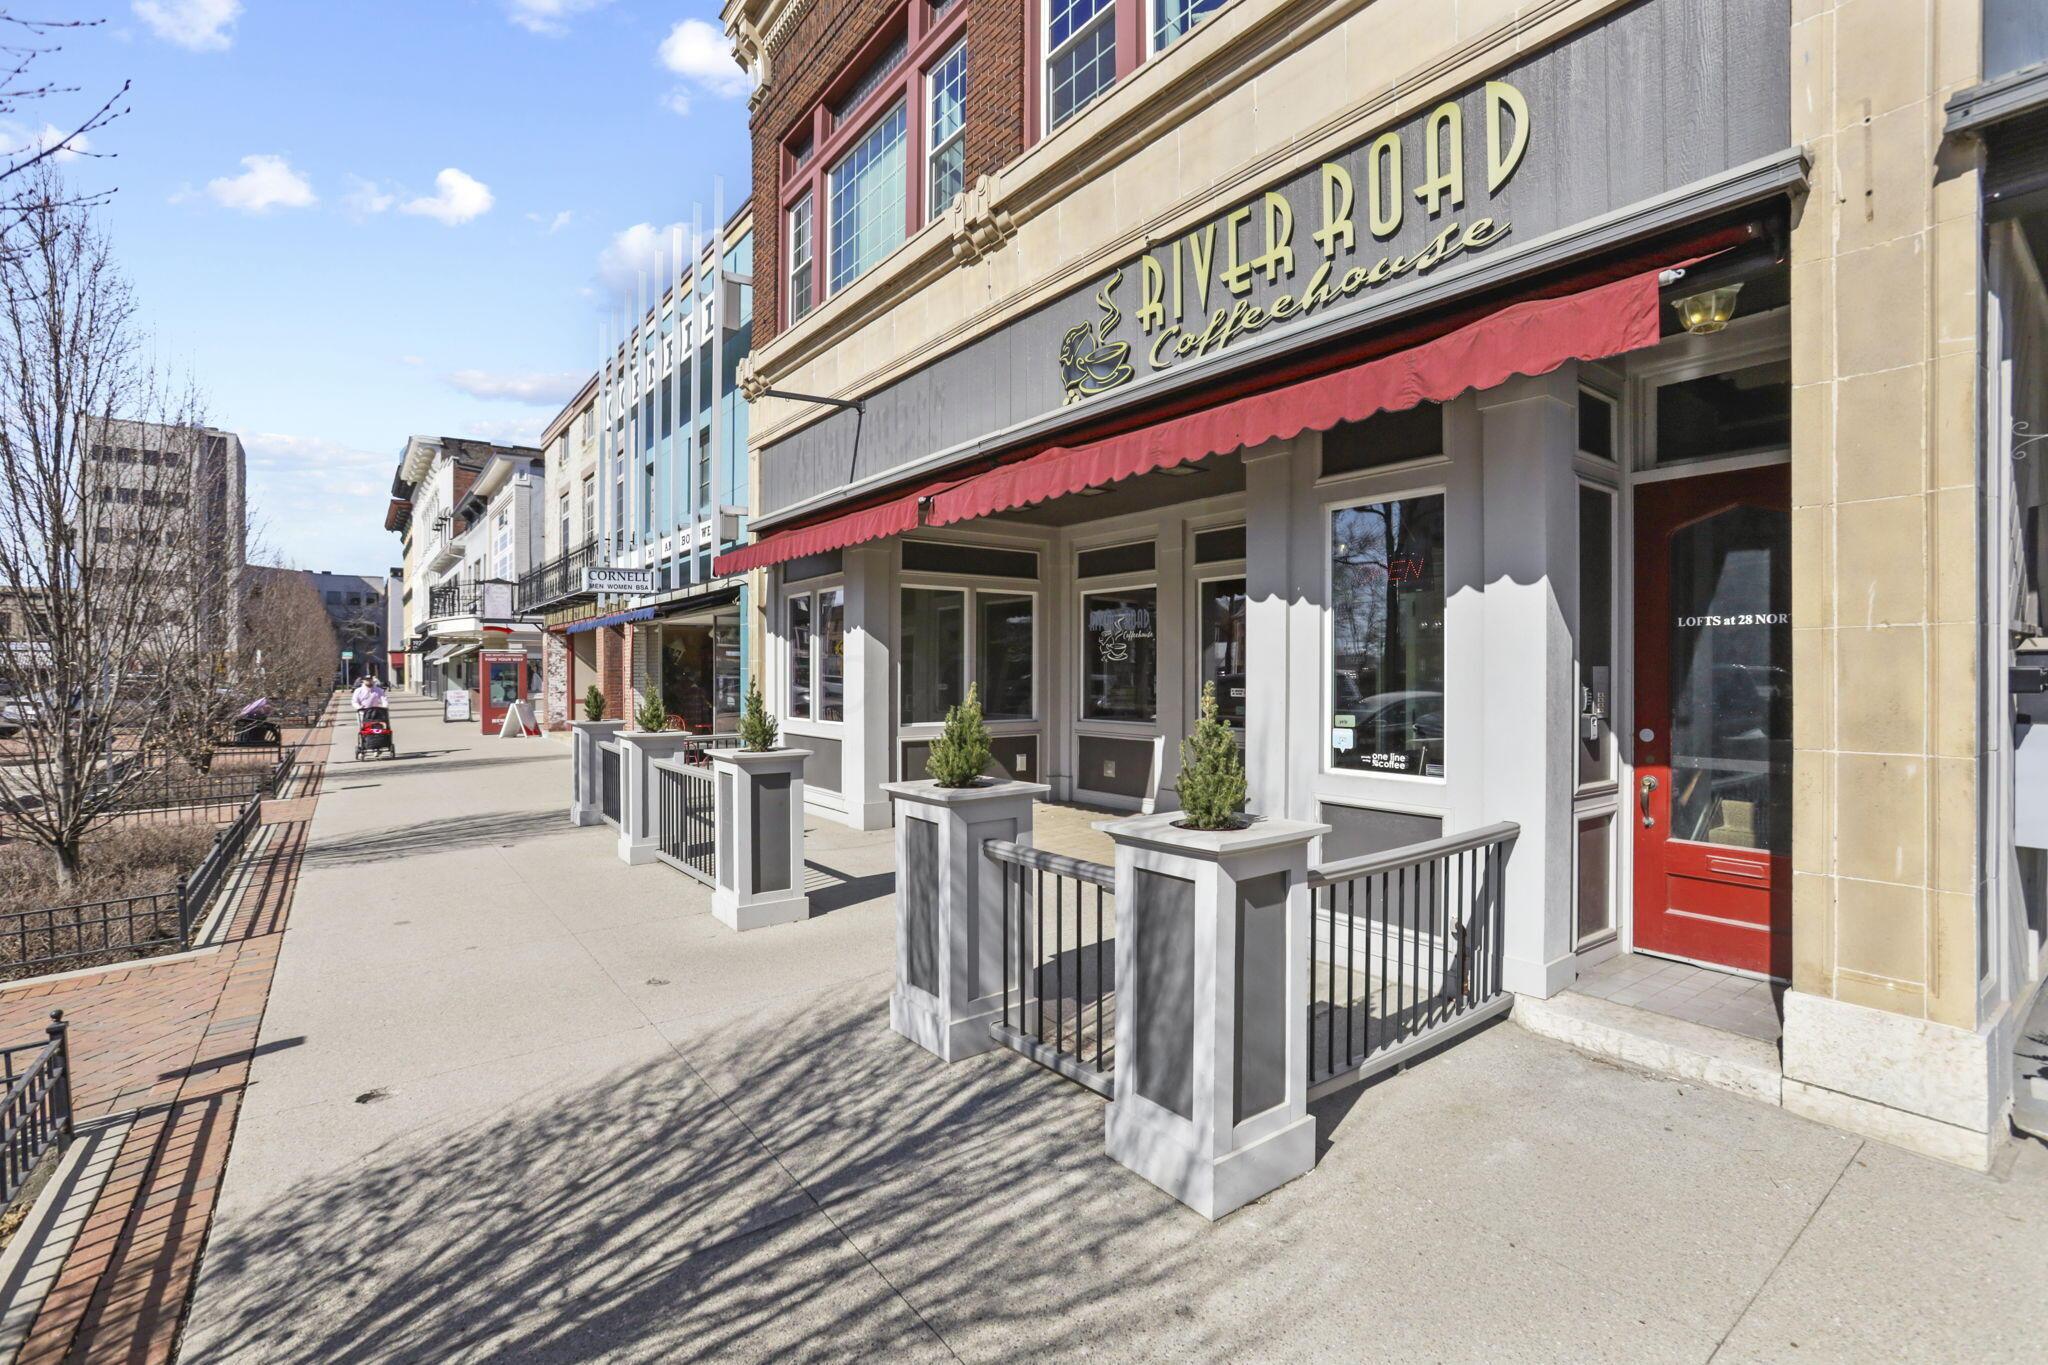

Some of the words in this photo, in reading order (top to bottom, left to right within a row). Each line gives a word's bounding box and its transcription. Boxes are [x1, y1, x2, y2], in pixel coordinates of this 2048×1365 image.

[1135, 192, 1295, 332] RIVER
[1312, 81, 1531, 259] ROAD
[1148, 217, 1512, 369] Coffeehouse
[588, 570, 649, 582] CORNELL
[1677, 615, 1721, 627] LOFTS
[1723, 616, 1736, 626] at
[1738, 614, 1753, 626] 28
[1755, 613, 1792, 625] NOR
[1371, 753, 1388, 761] one
[1390, 752, 1406, 762] line
[1378, 760, 1406, 770] coffee
